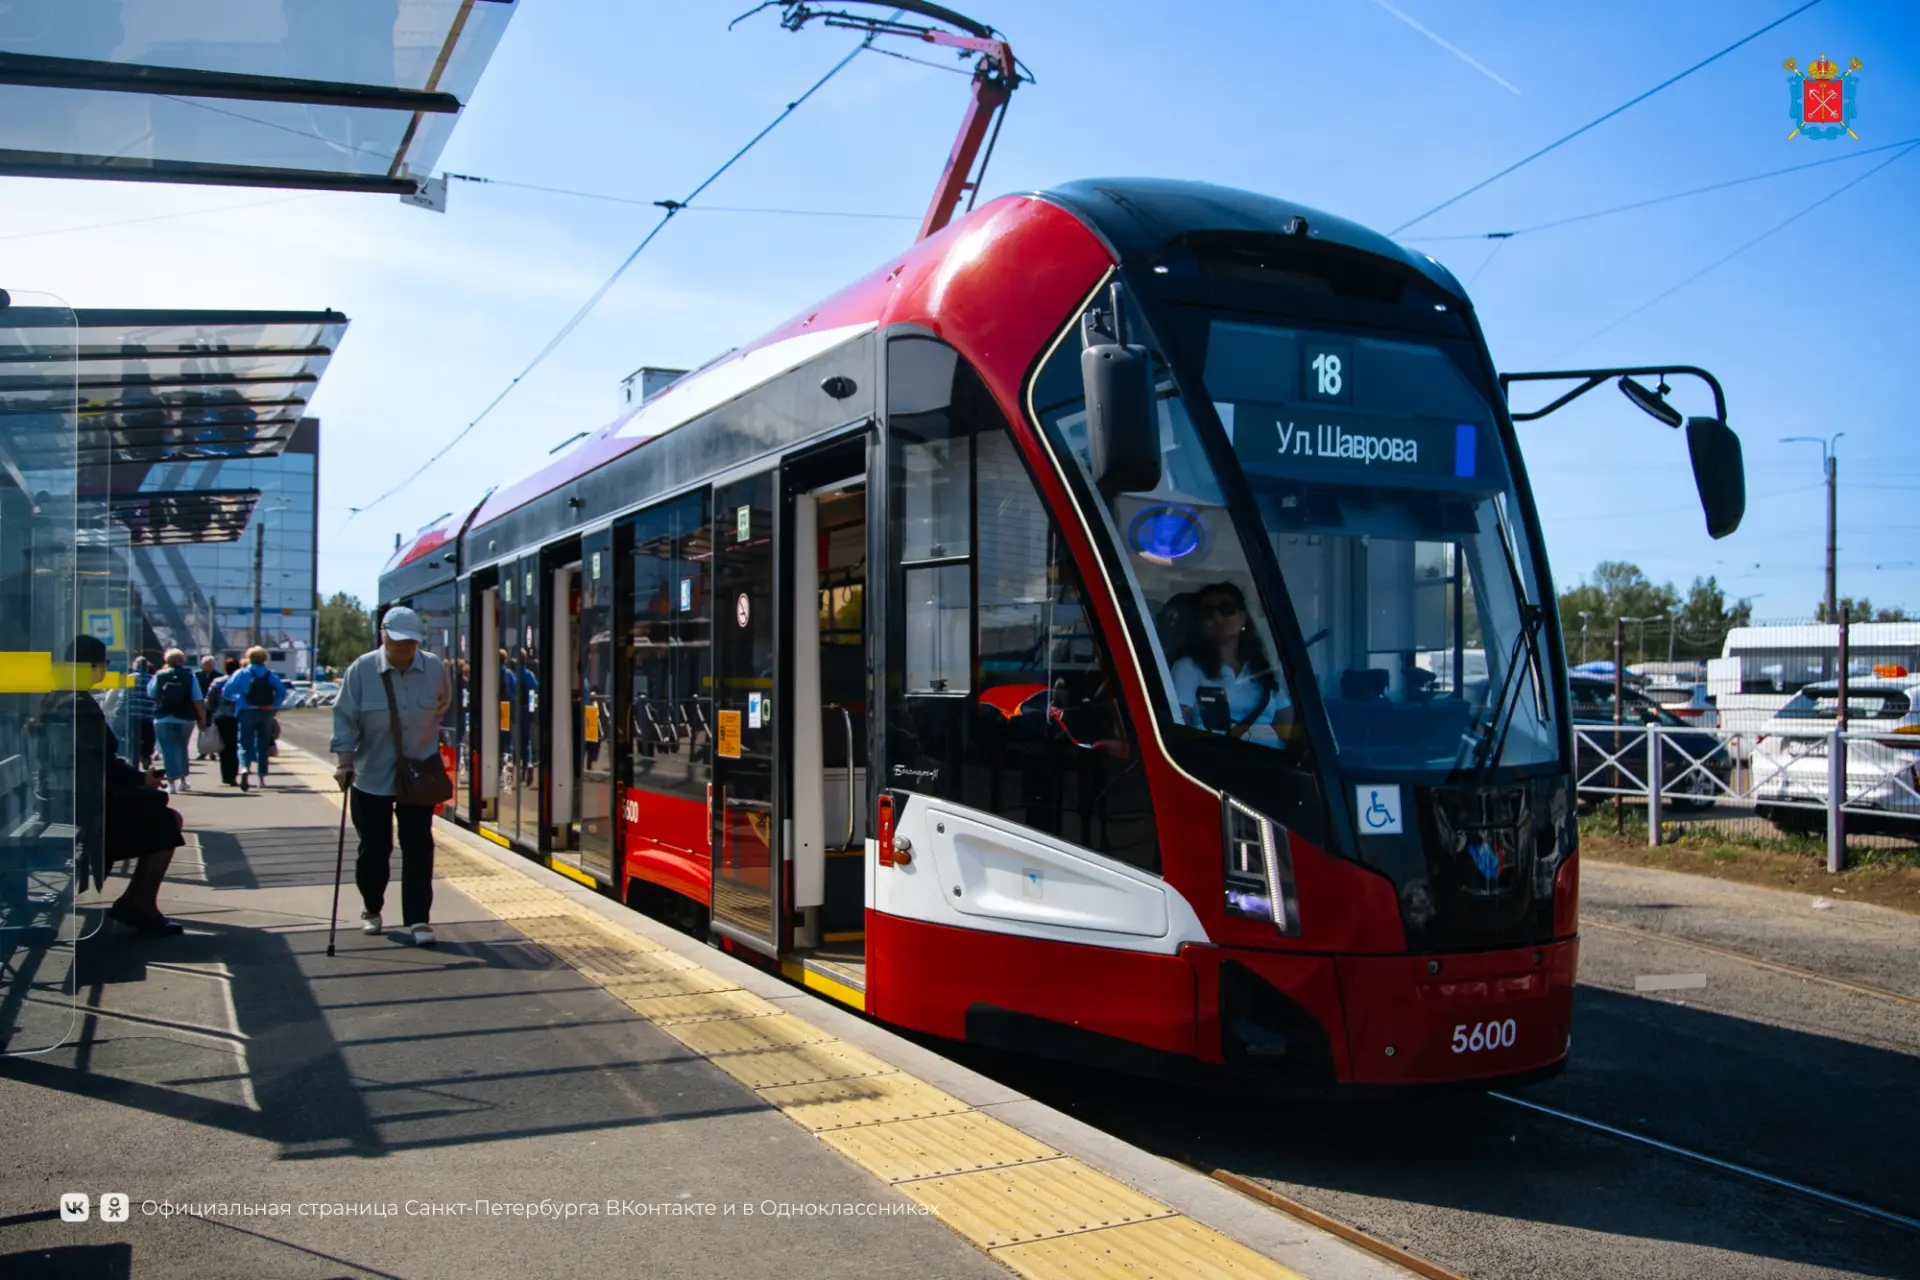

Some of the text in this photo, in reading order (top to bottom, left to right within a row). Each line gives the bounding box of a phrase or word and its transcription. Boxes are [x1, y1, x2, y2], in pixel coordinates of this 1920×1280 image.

[1312, 353, 1342, 395] 18
[1276, 421, 1418, 465] Ул. Шаврова
[1451, 1018, 1516, 1053] 5600
